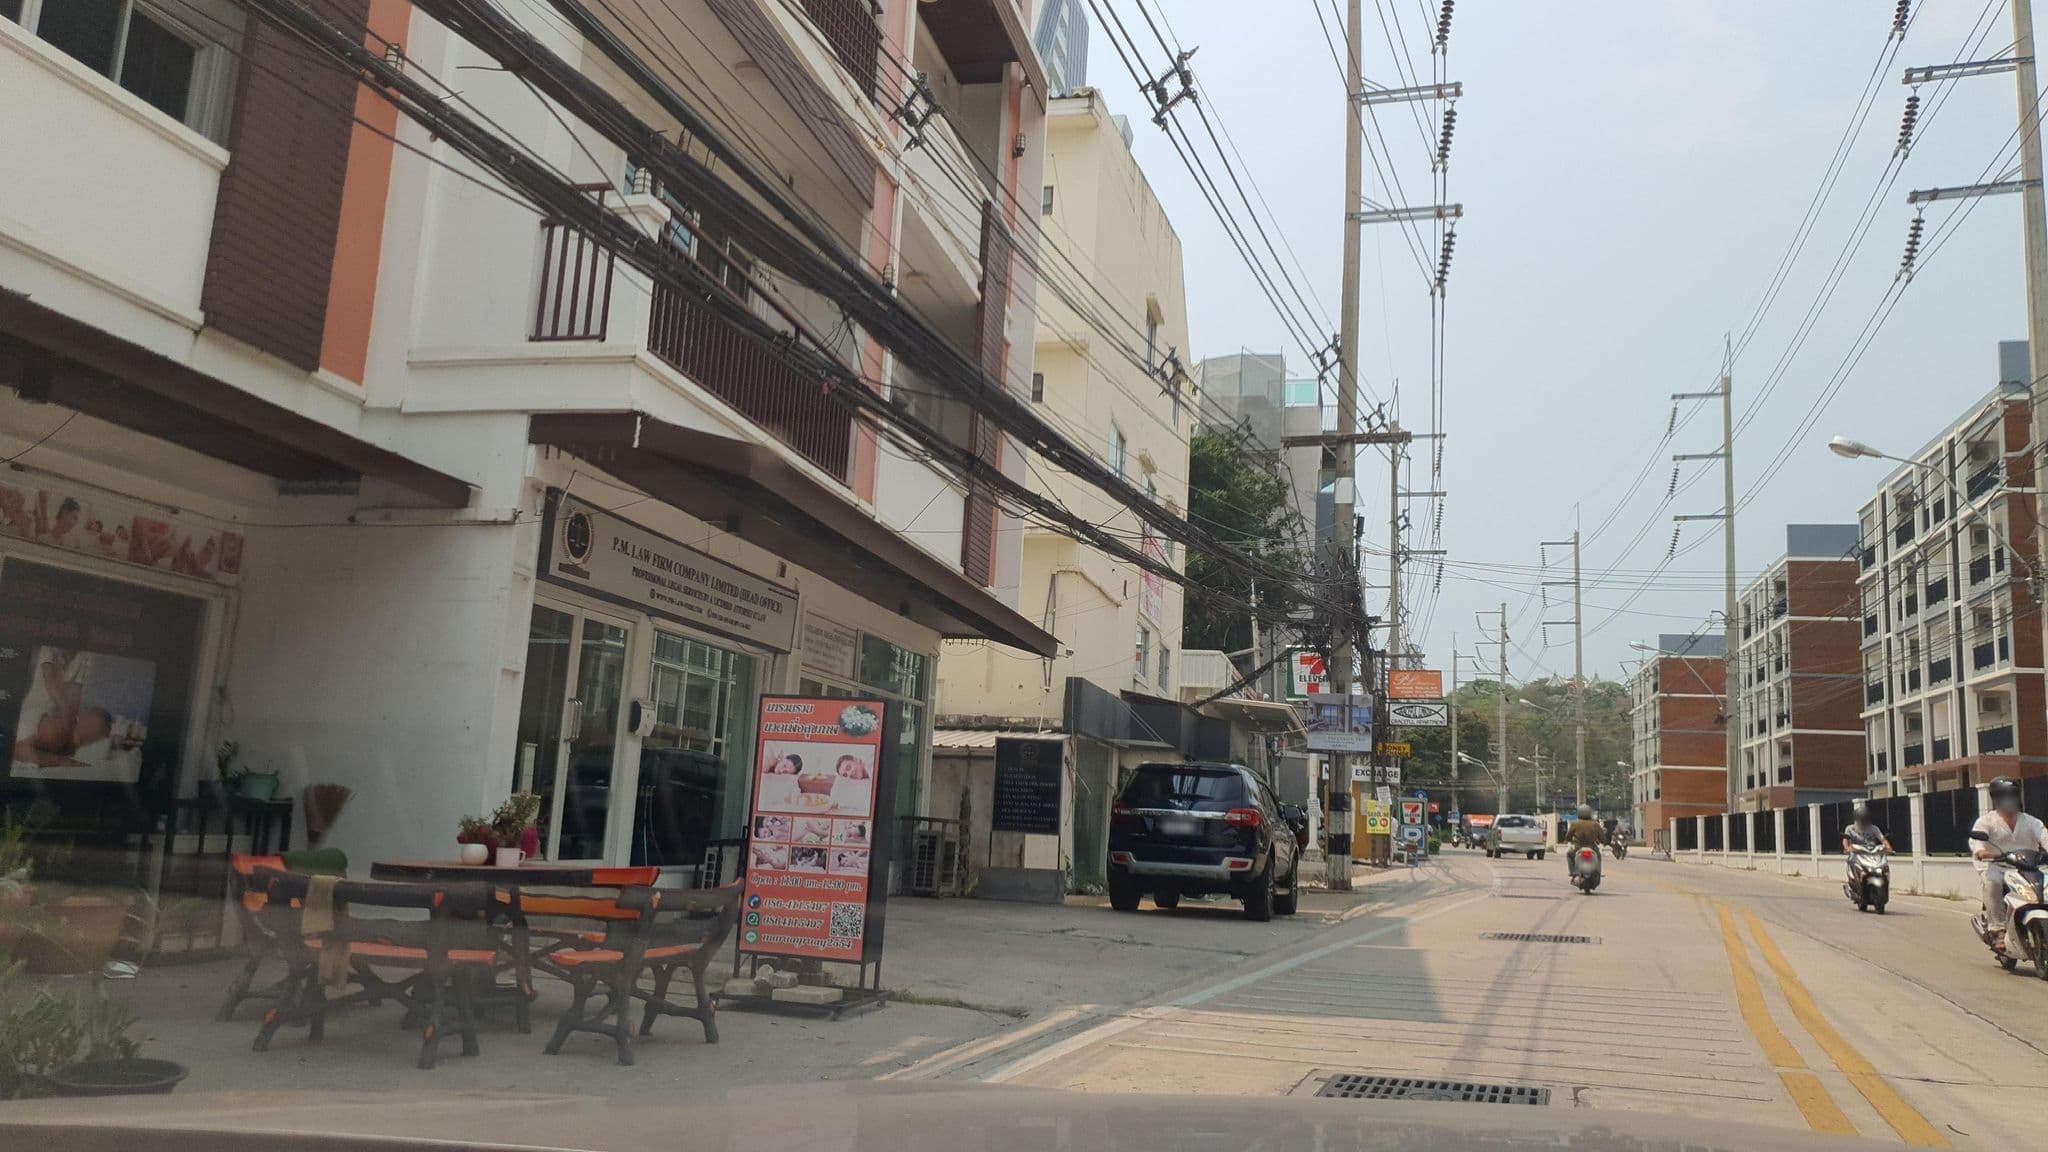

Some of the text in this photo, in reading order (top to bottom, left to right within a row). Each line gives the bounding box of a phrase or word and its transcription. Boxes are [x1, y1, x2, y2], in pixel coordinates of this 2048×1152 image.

[631, 544, 650, 563] LAW
[652, 552, 673, 572] FIRM
[673, 561, 711, 586] COMPANY
[711, 576, 738, 598] LIMITED
